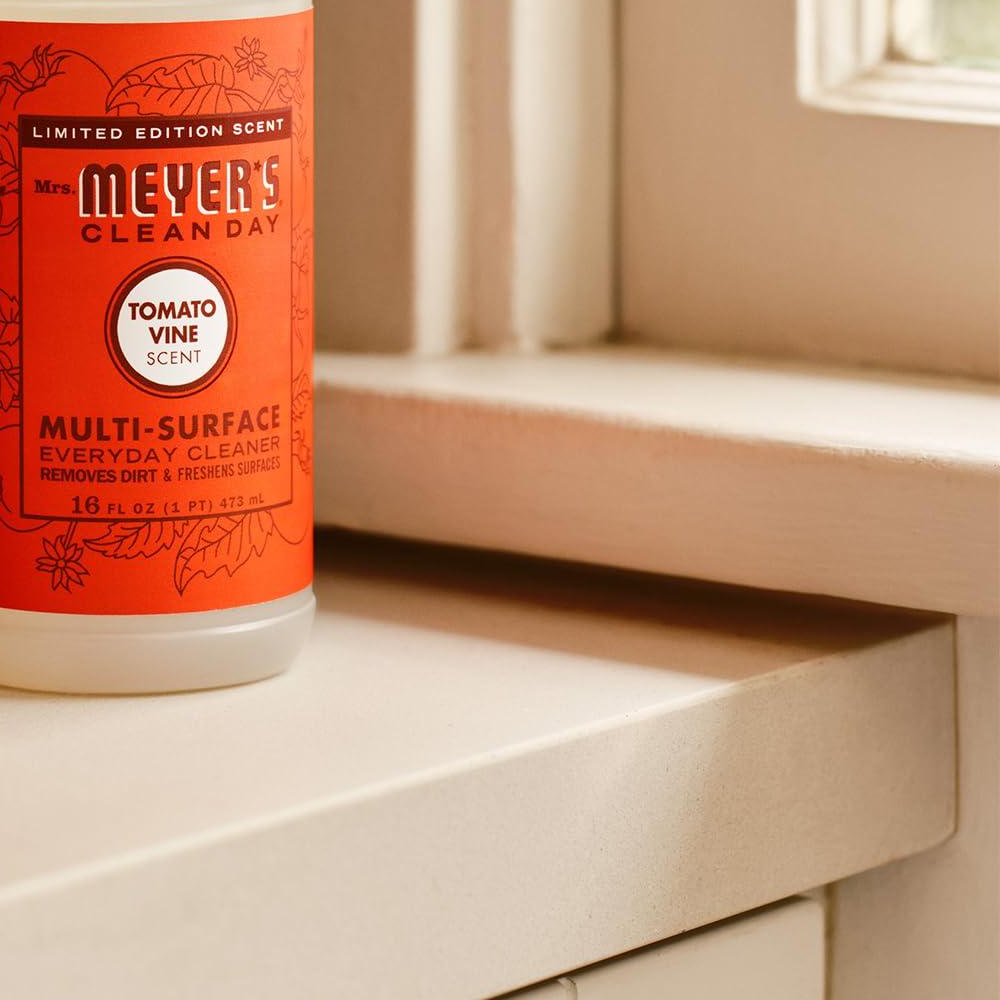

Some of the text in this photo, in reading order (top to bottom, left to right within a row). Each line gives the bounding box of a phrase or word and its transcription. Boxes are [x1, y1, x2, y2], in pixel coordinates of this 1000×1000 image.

[32, 118, 285, 140] LIMITED EDITION SCENT
[34, 179, 76, 195] Mrs.
[81, 215, 280, 243] CLEAN DAY
[128, 299, 216, 320] TOMATO
[149, 325, 198, 344] VINE
[147, 350, 201, 365] SCENT
[40, 405, 280, 441] MULTI-SURFACE
[40, 435, 281, 464] EVERYDAY CLEANER
[40, 455, 281, 484] REMOVES DIRT & FRESHENS SURFACES
[71, 493, 265, 516] 16 FL OZ (1 PT) 473 mL
